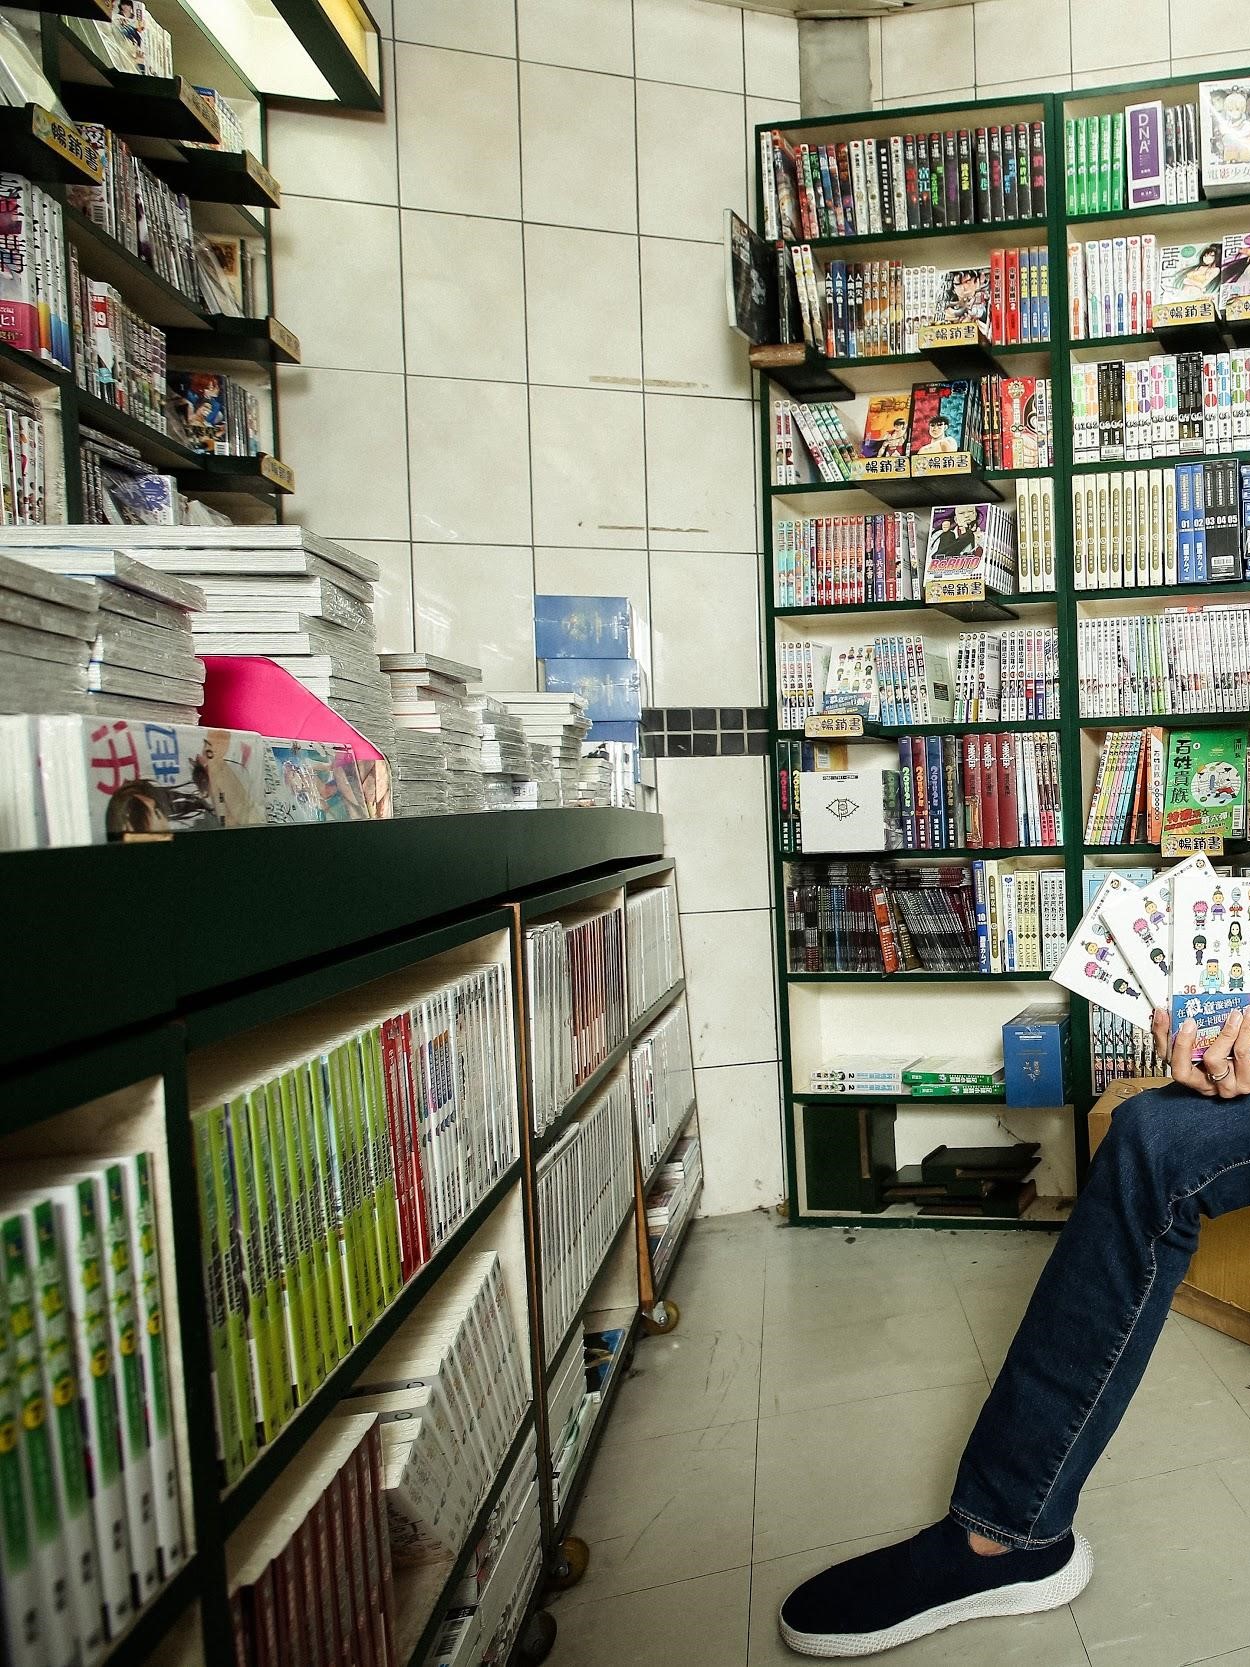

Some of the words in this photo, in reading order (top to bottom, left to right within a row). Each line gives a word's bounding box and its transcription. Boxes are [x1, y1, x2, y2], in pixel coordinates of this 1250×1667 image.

[51, 122, 100, 173] 暢銷書
[1207, 164, 1250, 181] 電影少女
[1169, 304, 1212, 319] 暢銷書
[935, 325, 976, 340] 暢銷書
[865, 458, 907, 474] 暢銷書
[928, 455, 969, 470] 暢銷書
[1181, 520, 1190, 529] 01
[1194, 518, 1204, 527] 02
[1205, 517, 1216, 526] 03
[1216, 515, 1227, 525] 04
[1227, 515, 1238, 524] 05
[928, 556, 980, 571] BORUTO
[942, 582, 983, 596] 暢銷書
[821, 717, 861, 731] 暢銷書
[967, 742, 980, 770] MONSTER
[981, 741, 997, 769] MONSTER
[999, 740, 1015, 770] MONSTER
[1170, 739, 1192, 804] 百姓貴族
[1179, 836, 1221, 850] 暢銷書
[1184, 985, 1197, 995] 36
